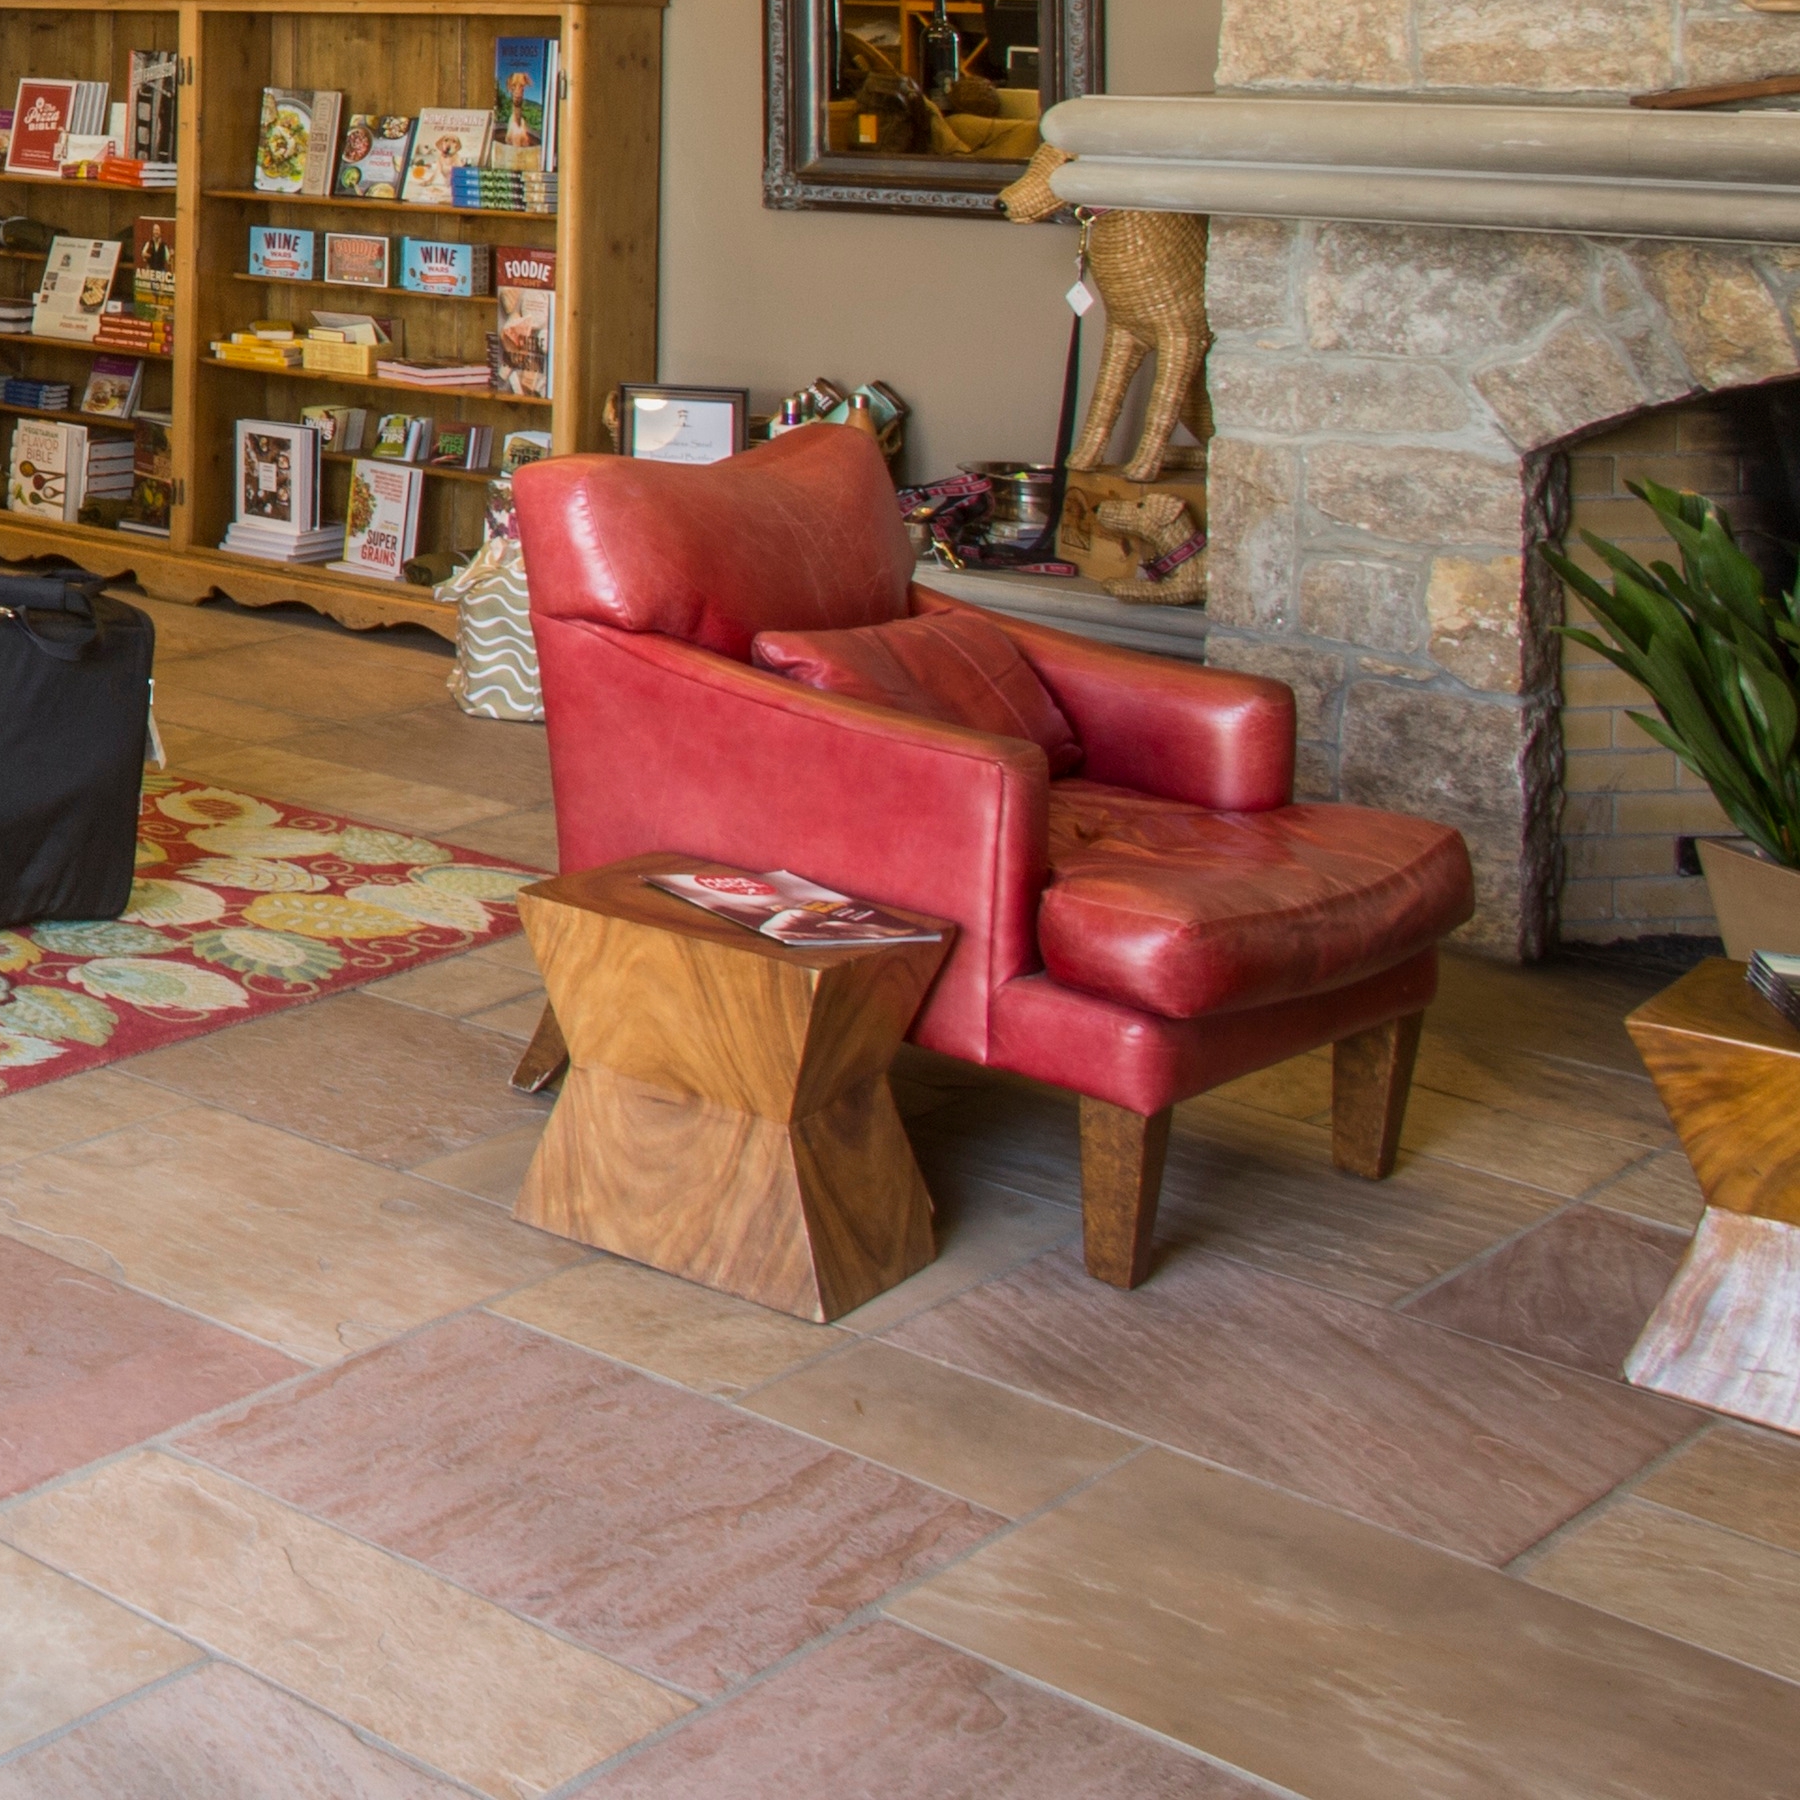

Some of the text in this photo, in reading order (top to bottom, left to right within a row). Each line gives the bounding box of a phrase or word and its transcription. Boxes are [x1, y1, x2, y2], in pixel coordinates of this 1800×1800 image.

[24, 107, 60, 124] Pizza
[28, 122, 57, 131] BIBLE
[263, 232, 301, 252] WINE
[420, 246, 458, 267] WINE
[504, 260, 552, 282] FOODIE
[305, 418, 335, 429] WINE
[21, 434, 59, 450] FLAVOR
[381, 433, 404, 444] TIPS
[26, 448, 53, 464] BIBLE
[439, 444, 464, 456] TIPS
[366, 529, 397, 551] SUPER
[361, 544, 396, 567] GRAINS
